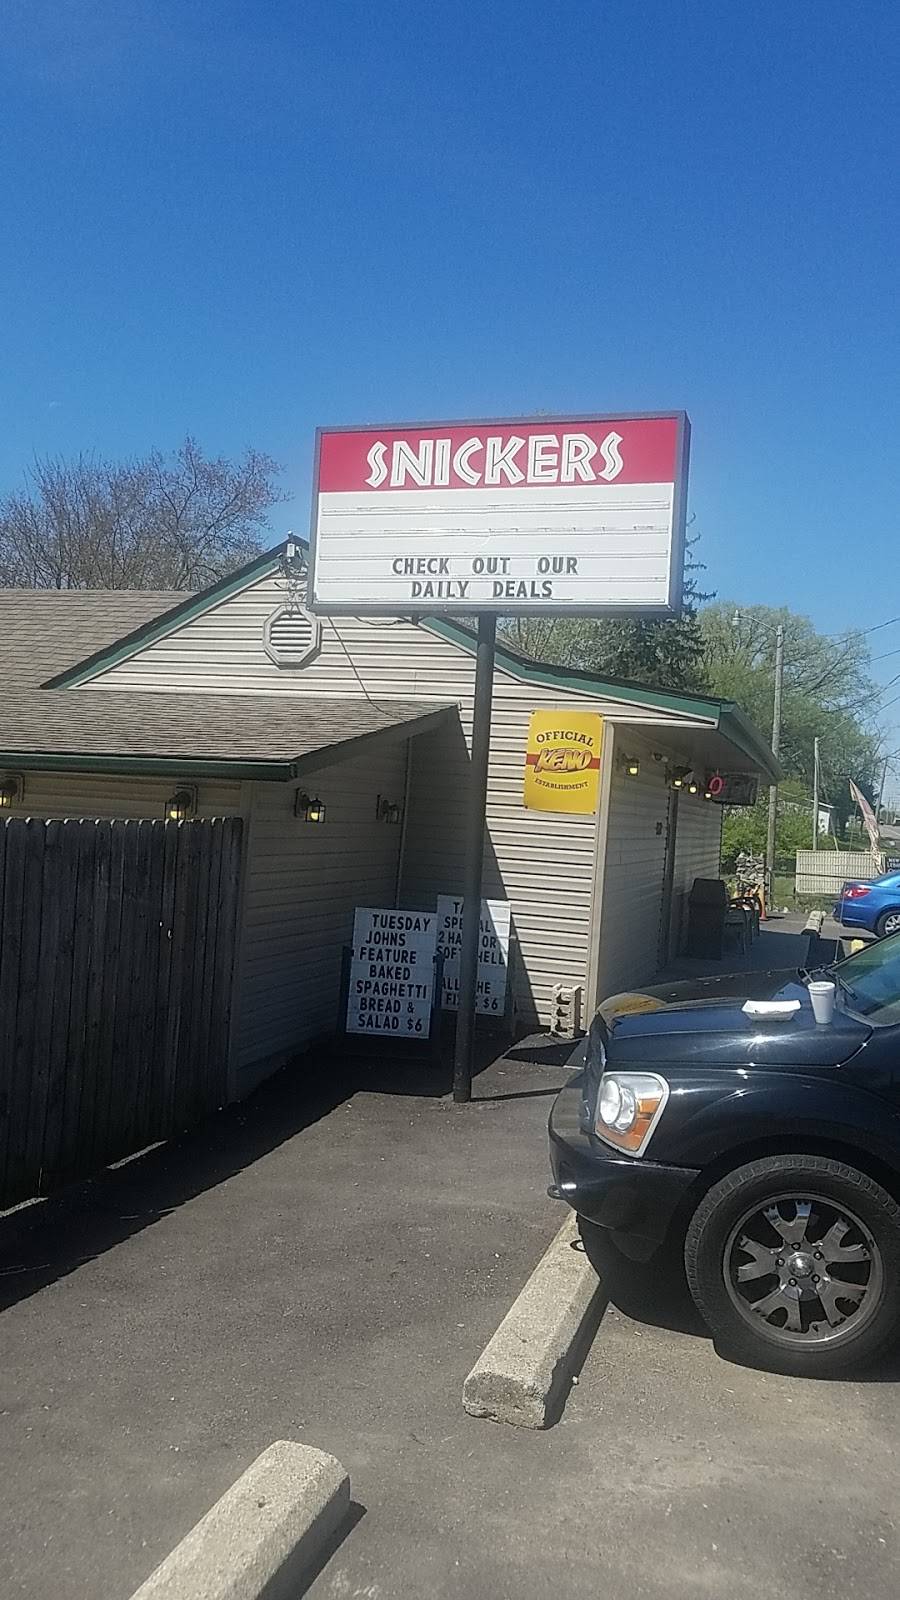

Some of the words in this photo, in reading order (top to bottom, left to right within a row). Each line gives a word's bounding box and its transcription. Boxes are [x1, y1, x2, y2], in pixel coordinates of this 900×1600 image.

[364, 431, 624, 489] SNICKERS
[392, 557, 450, 575] CHECK
[472, 557, 510, 574] OUT
[538, 556, 578, 574] OUR
[411, 580, 469, 598] DAILY
[492, 580, 552, 598] DEALS
[536, 731, 594, 747] OFFICIAL
[534, 748, 593, 773] KENO
[535, 778, 588, 790] ESTABLISHMENT
[372, 914, 431, 932] TUESDAY
[365, 931, 406, 947] JOHNS
[438, 931, 445, 943] 2
[482, 935, 496, 948] OR
[360, 947, 417, 964] FEATURE
[369, 965, 411, 980] BAKED
[356, 980, 427, 999] SPAGHETTI
[360, 997, 401, 1013] BREAD
[407, 1001, 414, 1013] &
[358, 1014, 399, 1030] SALAD
[407, 1017, 422, 1032] $6
